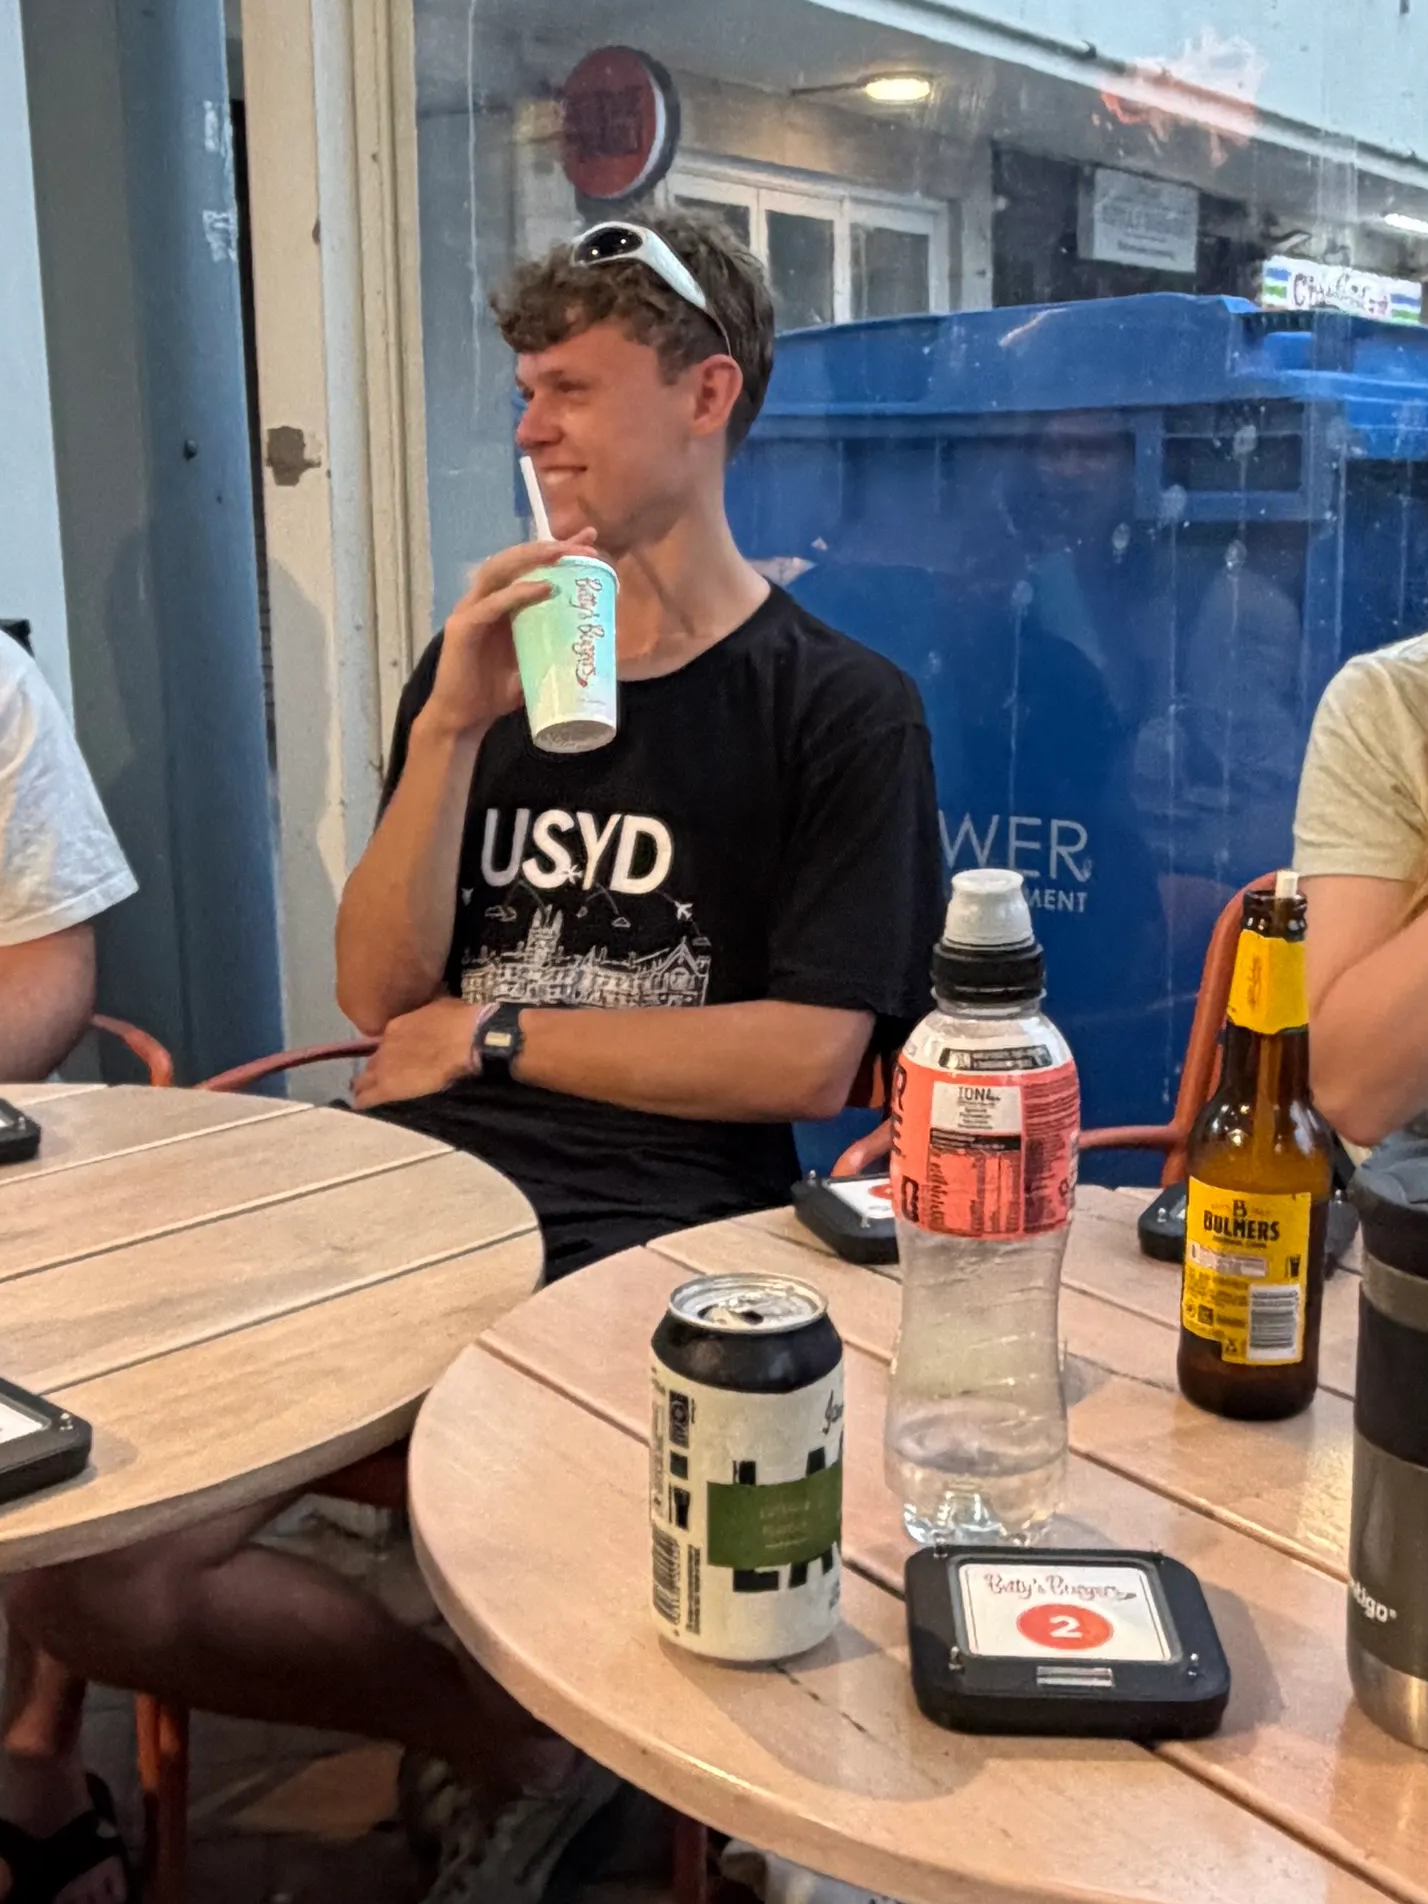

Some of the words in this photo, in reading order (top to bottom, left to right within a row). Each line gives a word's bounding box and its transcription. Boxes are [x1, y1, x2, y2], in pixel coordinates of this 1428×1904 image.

[480, 807, 673, 895] USYD
[937, 808, 1091, 884] WER
[1028, 888, 1089, 914] MENT
[1203, 1209, 1280, 1242] BULMERS
[984, 1573, 1046, 1600] Betty's
[1046, 1574, 1137, 1601] Burgers
[1049, 1615, 1083, 1639] 2
